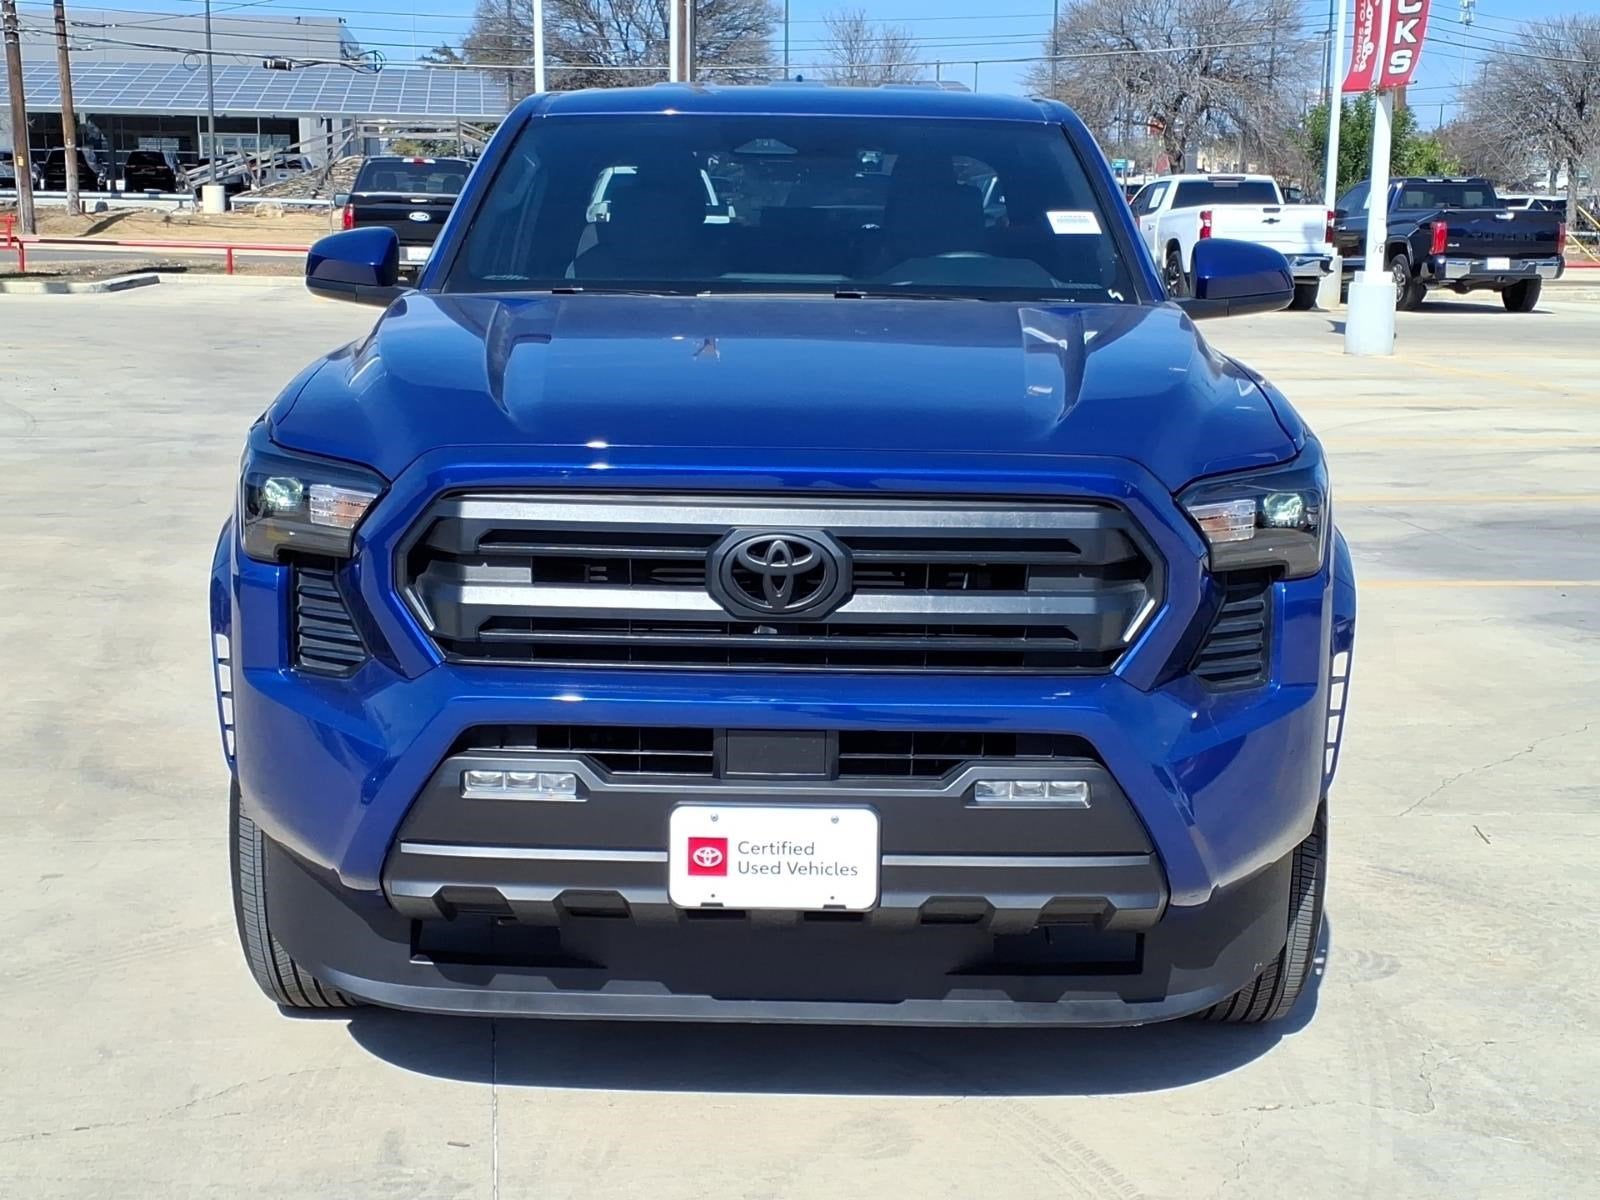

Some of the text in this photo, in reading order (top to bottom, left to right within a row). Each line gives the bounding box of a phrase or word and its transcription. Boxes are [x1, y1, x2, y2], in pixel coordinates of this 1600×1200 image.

[737, 841, 815, 856] Certified
[738, 861, 858, 876] Used Vehicles
